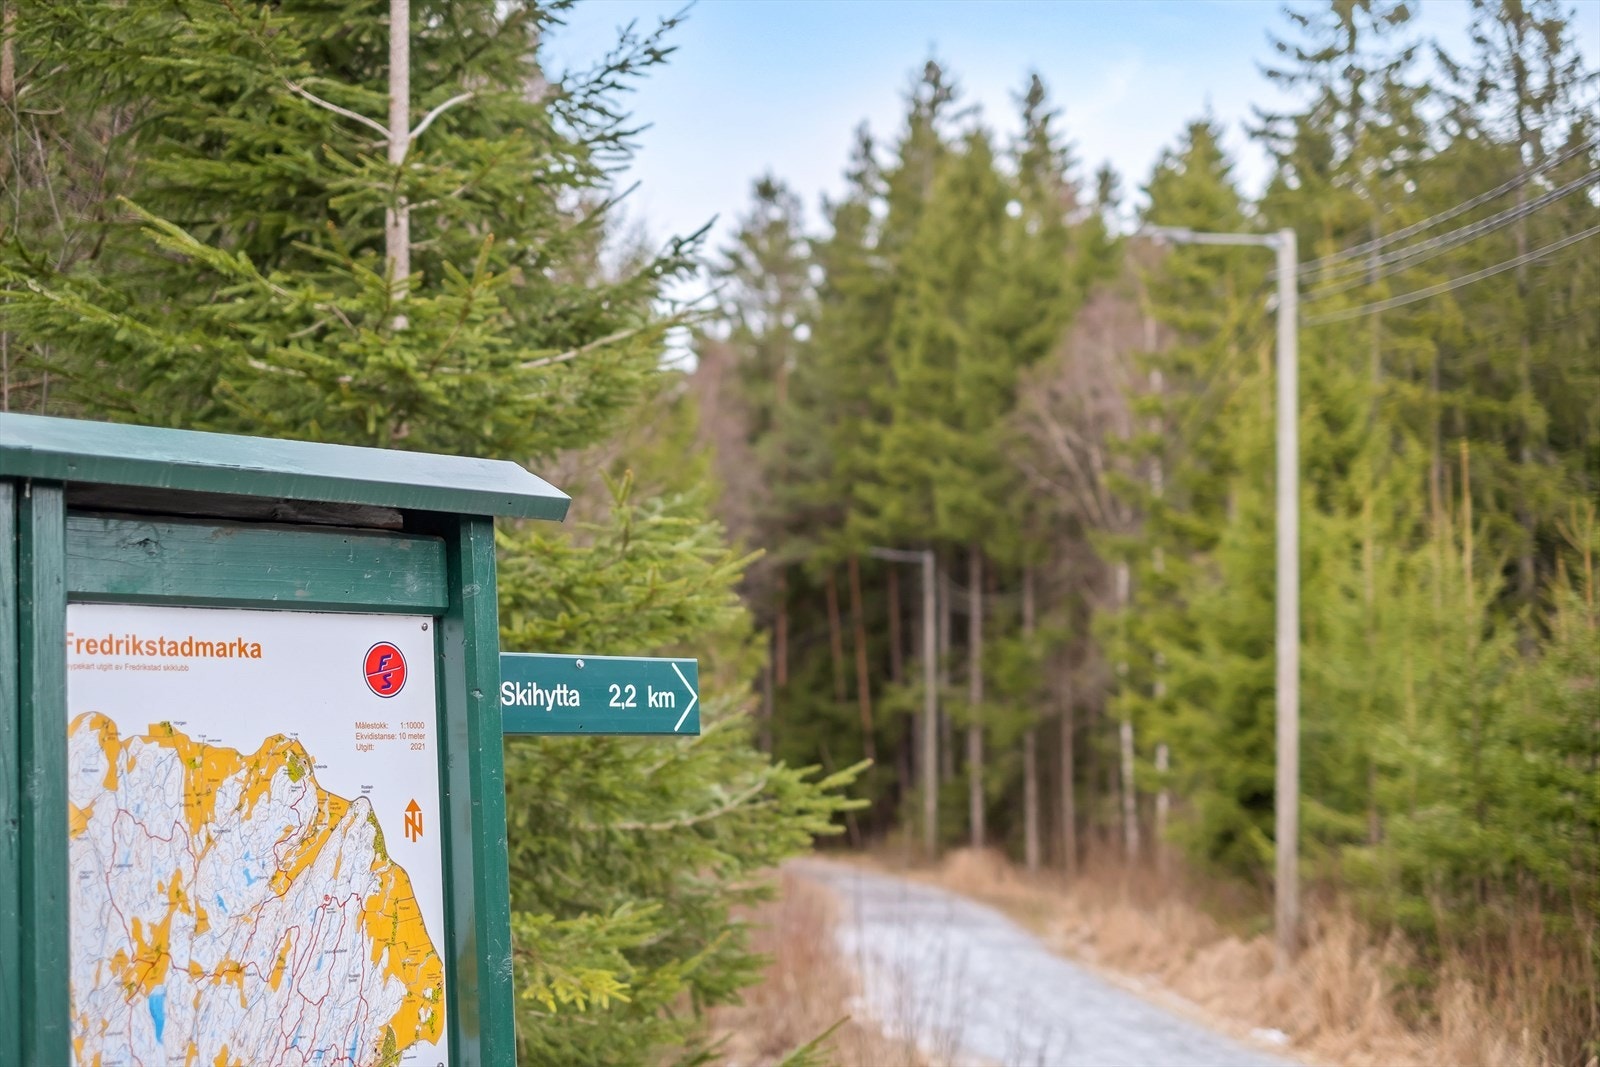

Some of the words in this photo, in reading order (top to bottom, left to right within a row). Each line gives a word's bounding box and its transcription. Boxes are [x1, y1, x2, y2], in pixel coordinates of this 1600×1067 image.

[67, 662, 95, 672] ypekart
[125, 662, 161, 671] Fredrikstad
[163, 663, 189, 672] skiklubb
[501, 681, 580, 711] Skihytta
[608, 684, 637, 710] 2,2
[648, 685, 675, 708] km
[355, 721, 389, 730] Målestokk:
[400, 721, 425, 730] 1:10000
[355, 732, 397, 741] Ekvidistanse:
[398, 732, 407, 740] 10
[408, 733, 426, 741] meter
[356, 743, 375, 753] Utgitt:
[410, 743, 425, 751] 2021
